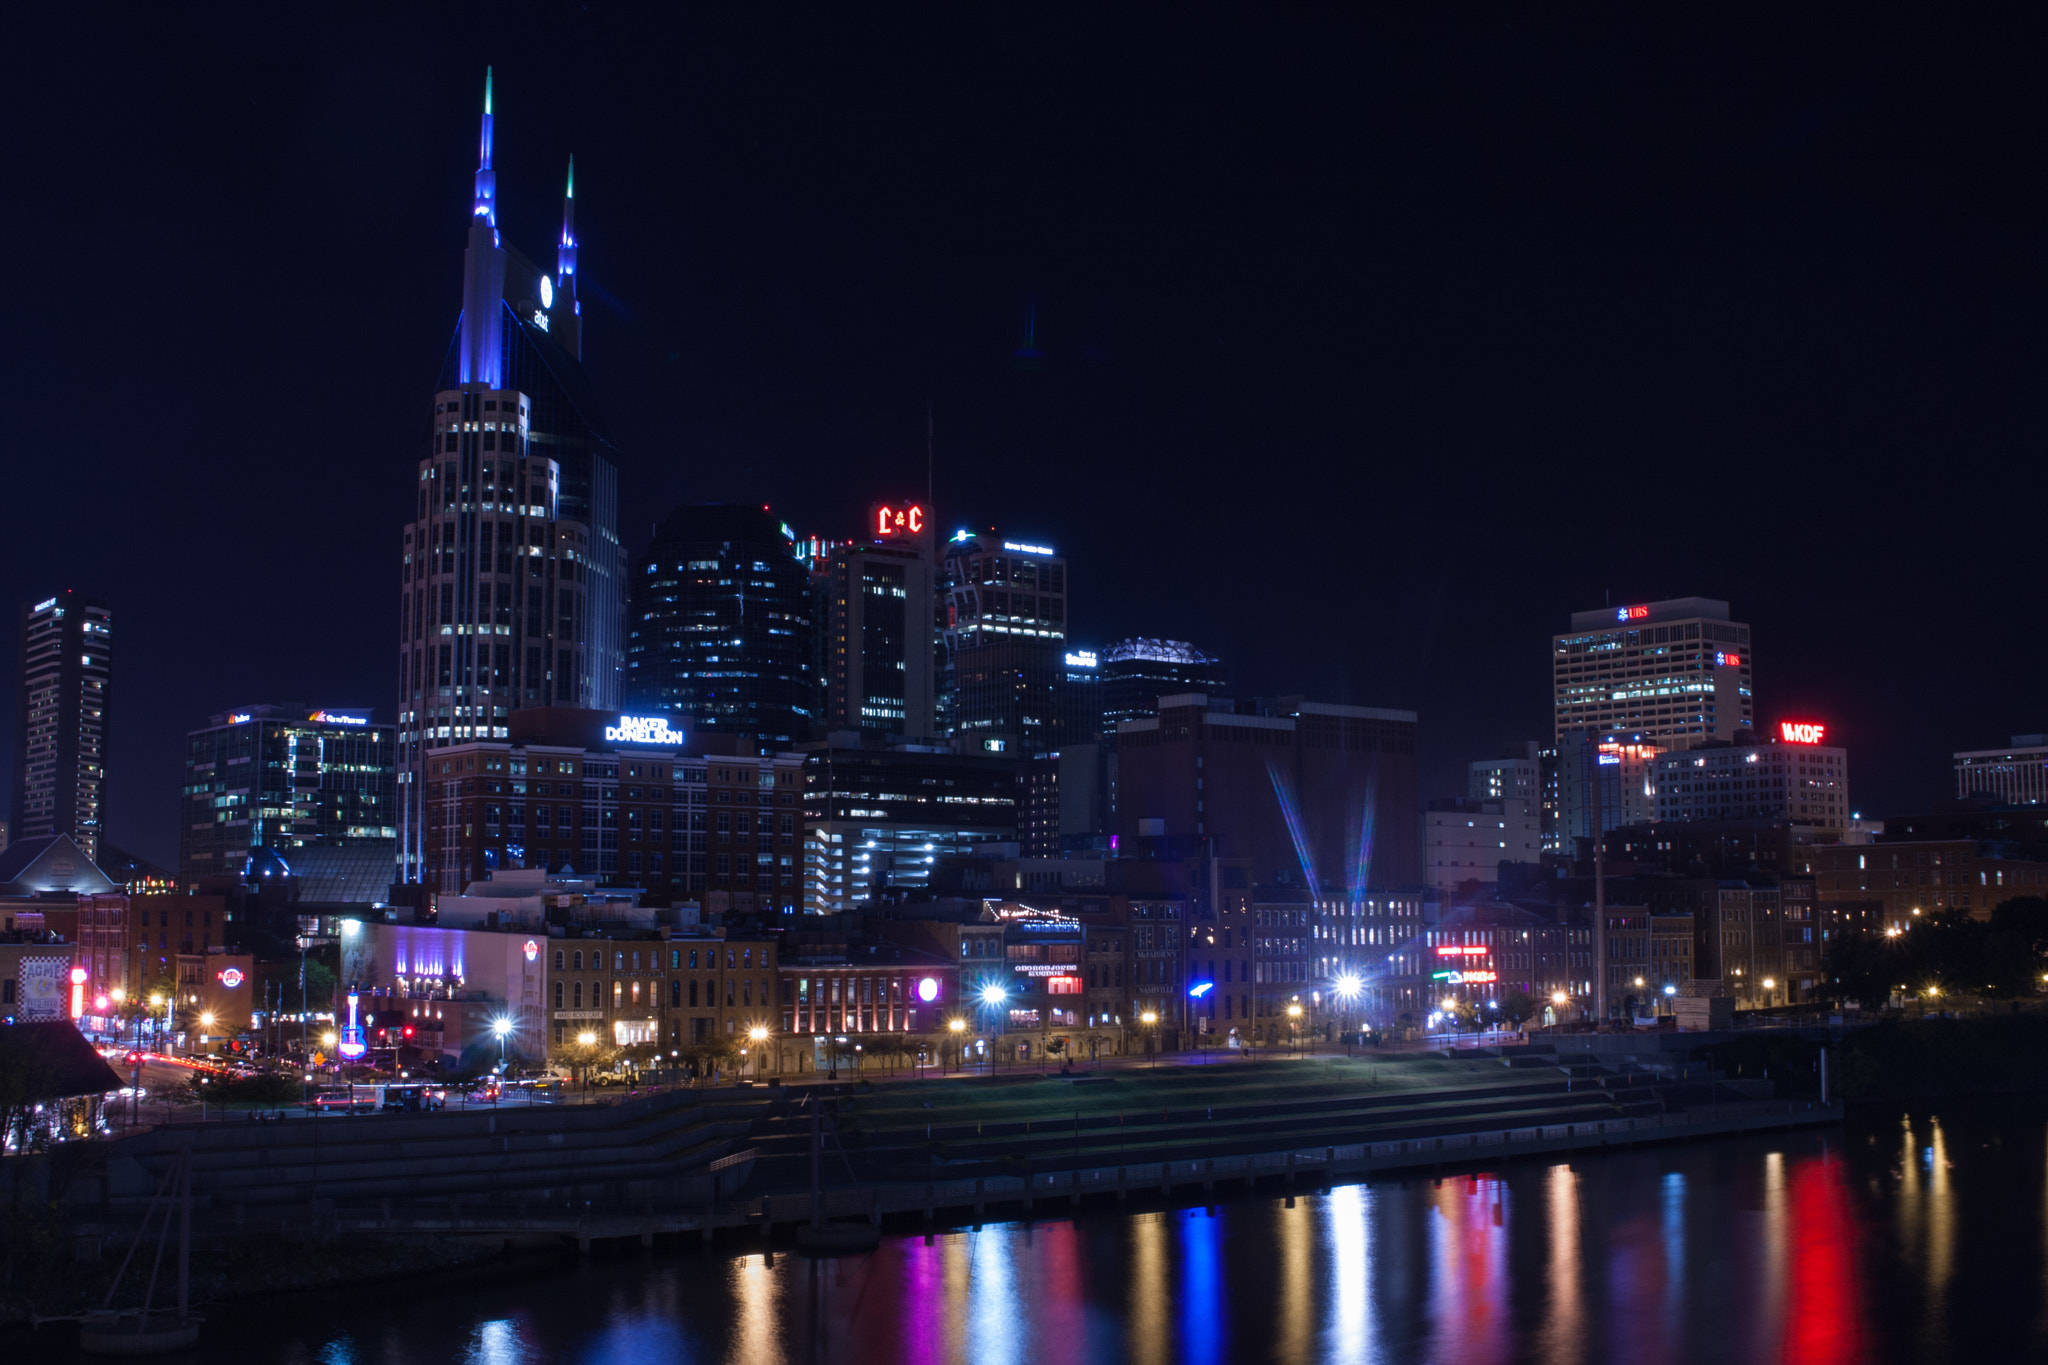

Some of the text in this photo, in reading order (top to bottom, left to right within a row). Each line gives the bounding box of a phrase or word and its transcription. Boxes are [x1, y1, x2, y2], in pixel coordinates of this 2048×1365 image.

[1628, 605, 1648, 619] UBS
[1725, 653, 1740, 666] UBS
[620, 715, 668, 732] BAKER
[605, 726, 683, 744] DONELSON
[1781, 722, 1824, 744] WKDF
[984, 739, 1006, 751] CMT
